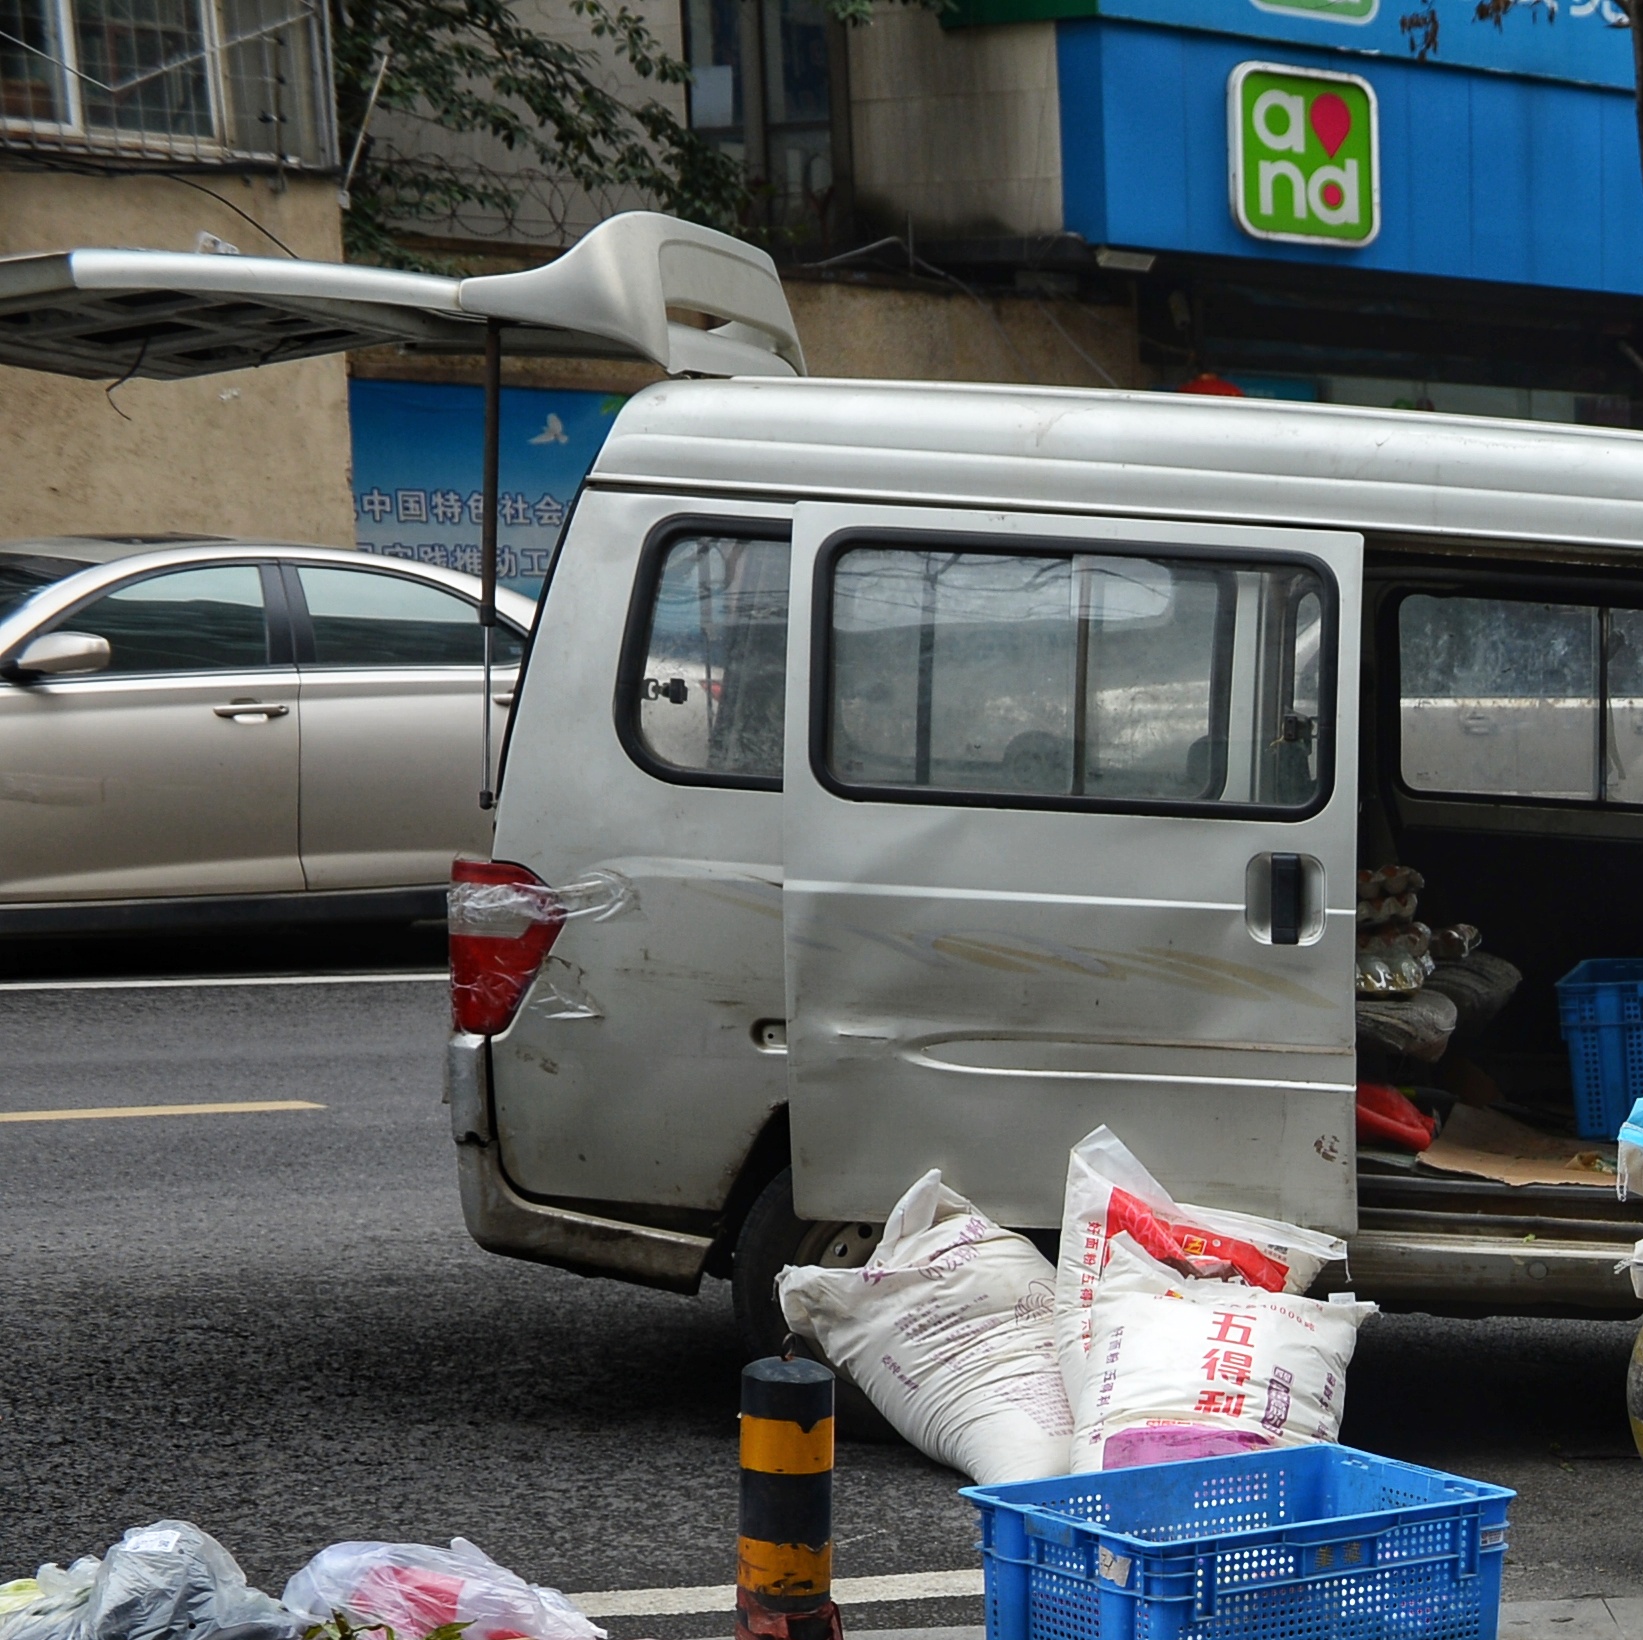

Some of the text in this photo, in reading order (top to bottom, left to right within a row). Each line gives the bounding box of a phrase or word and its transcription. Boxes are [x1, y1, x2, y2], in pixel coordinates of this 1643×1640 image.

[354, 487, 571, 526] 中国特色社会
[1194, 1310, 1258, 1418] 五得利
